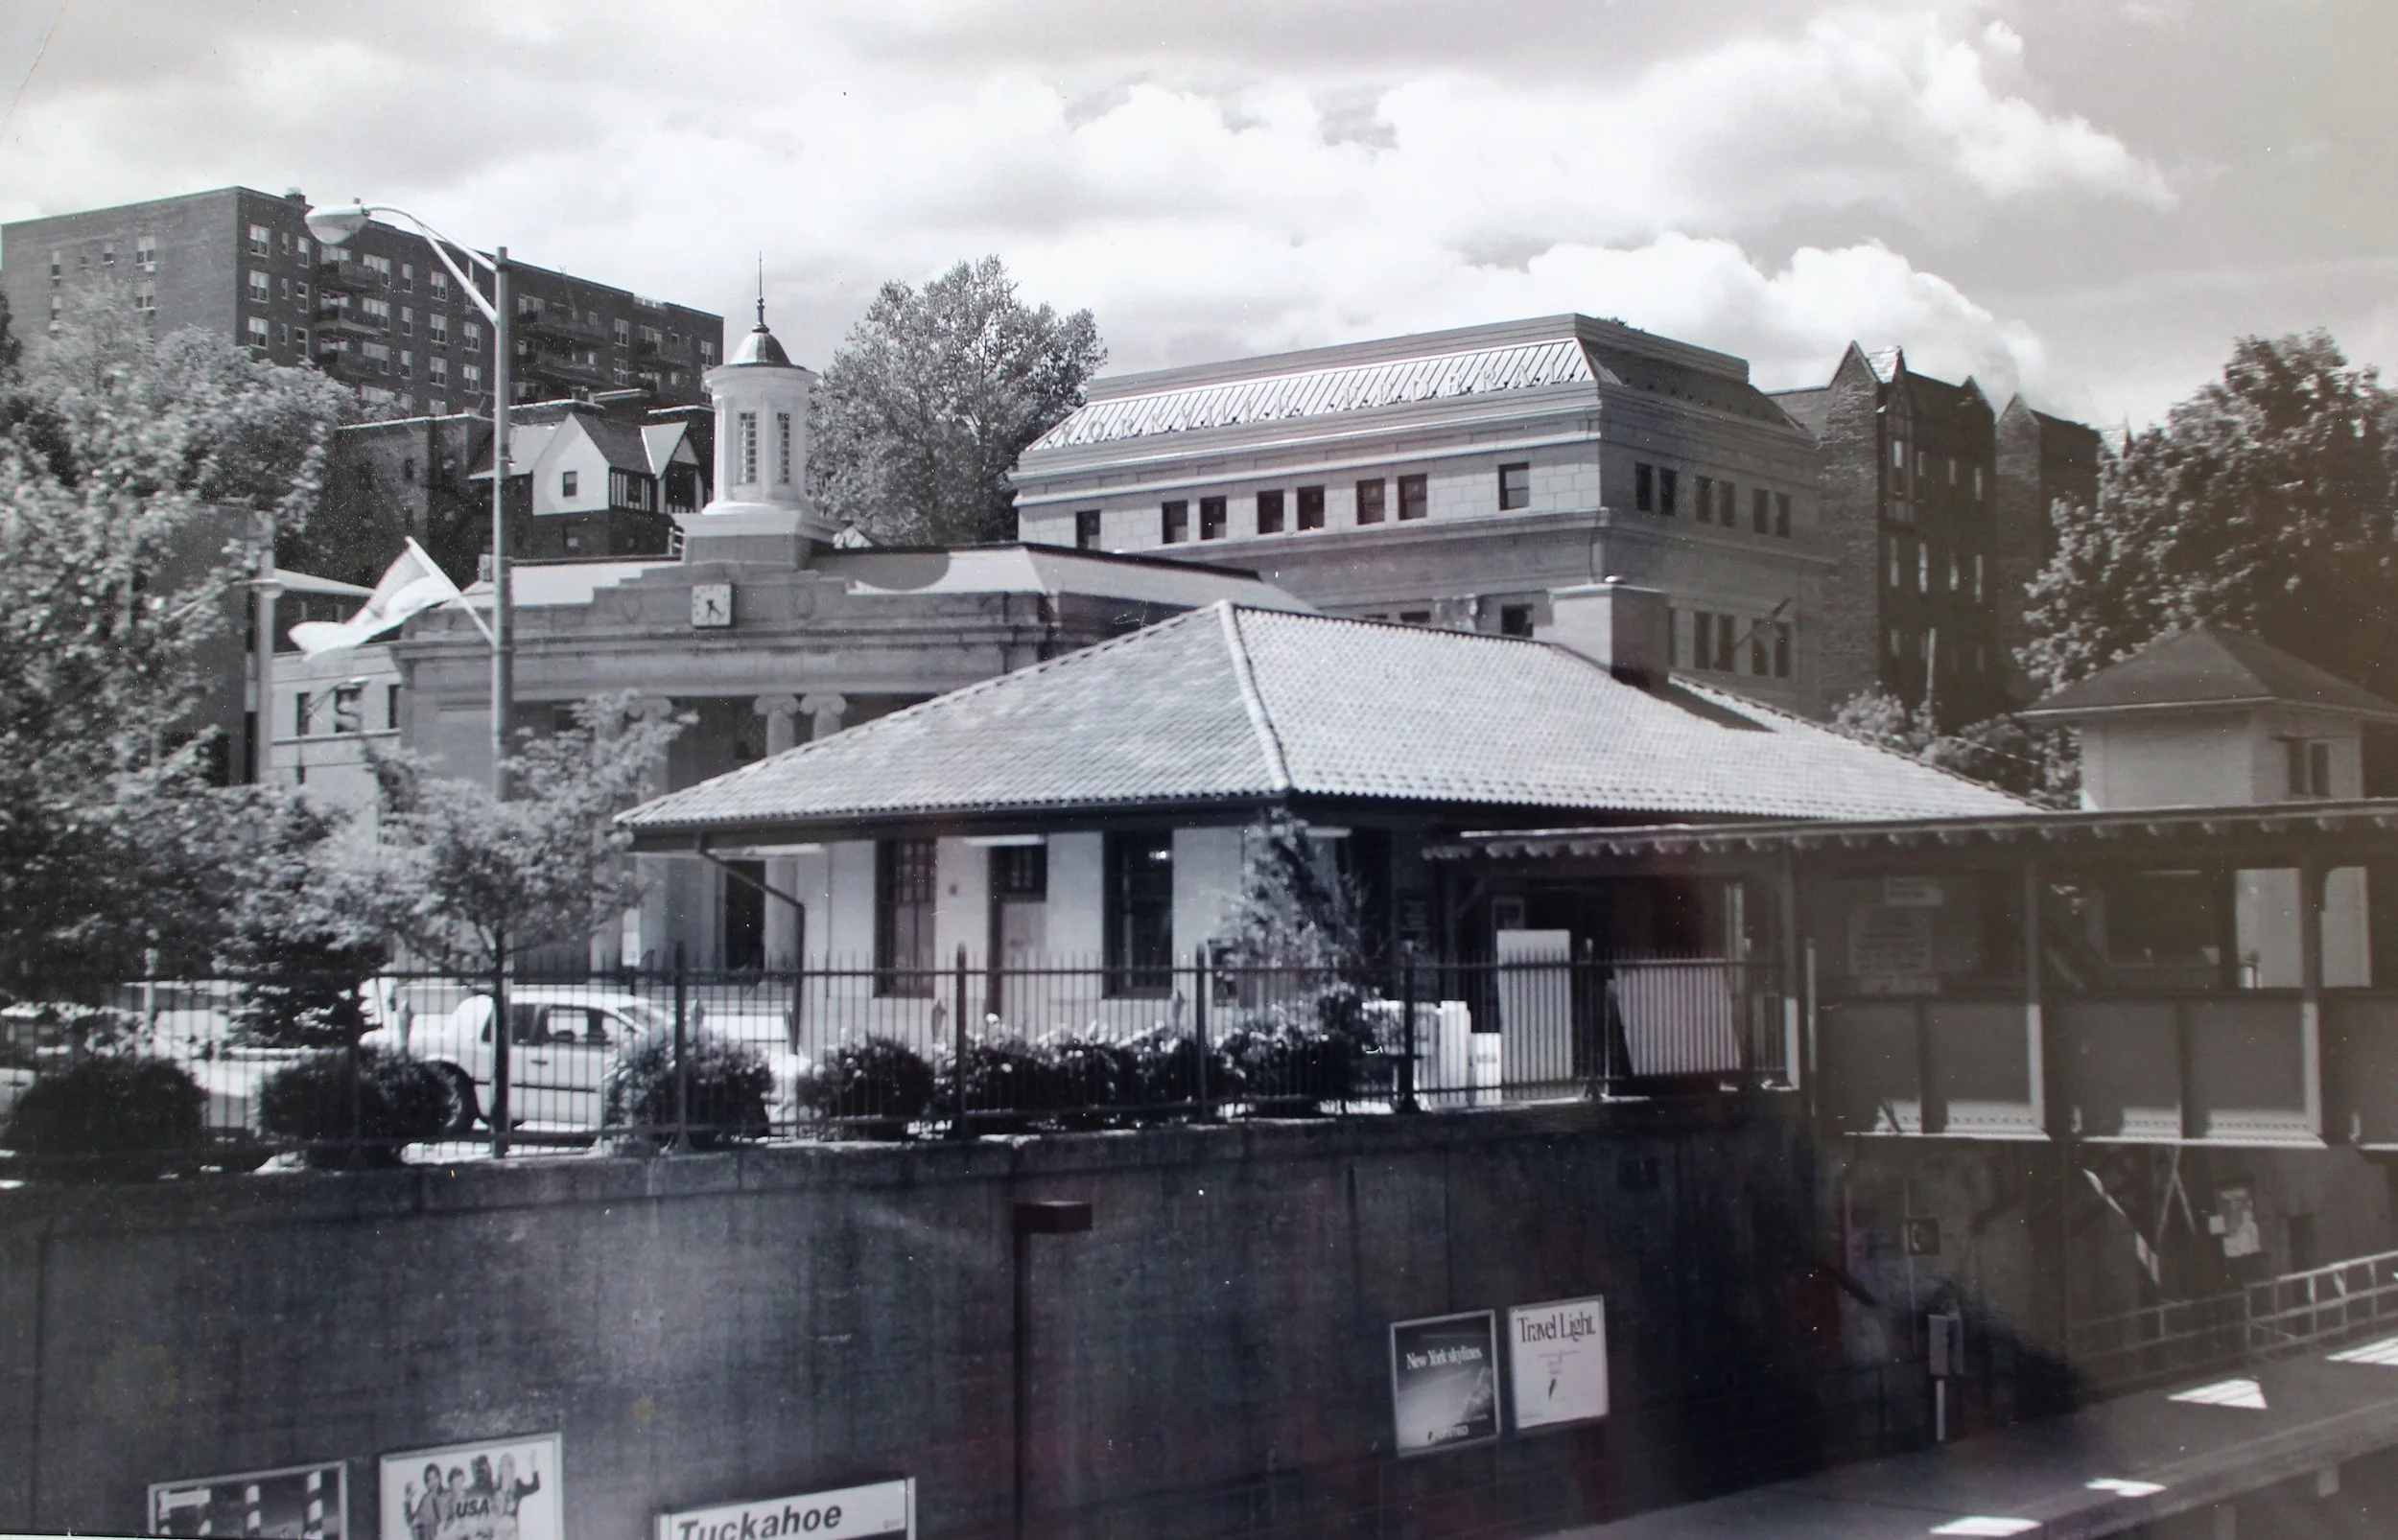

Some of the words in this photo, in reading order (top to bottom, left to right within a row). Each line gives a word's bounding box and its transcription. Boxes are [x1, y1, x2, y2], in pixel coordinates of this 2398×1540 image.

[1516, 1315, 1557, 1342] Travel
[1406, 1352, 1427, 1369] New
[1427, 1348, 1447, 1366] York
[456, 1498, 490, 1518] USA
[678, 1505, 842, 1539] Tuckahoe
